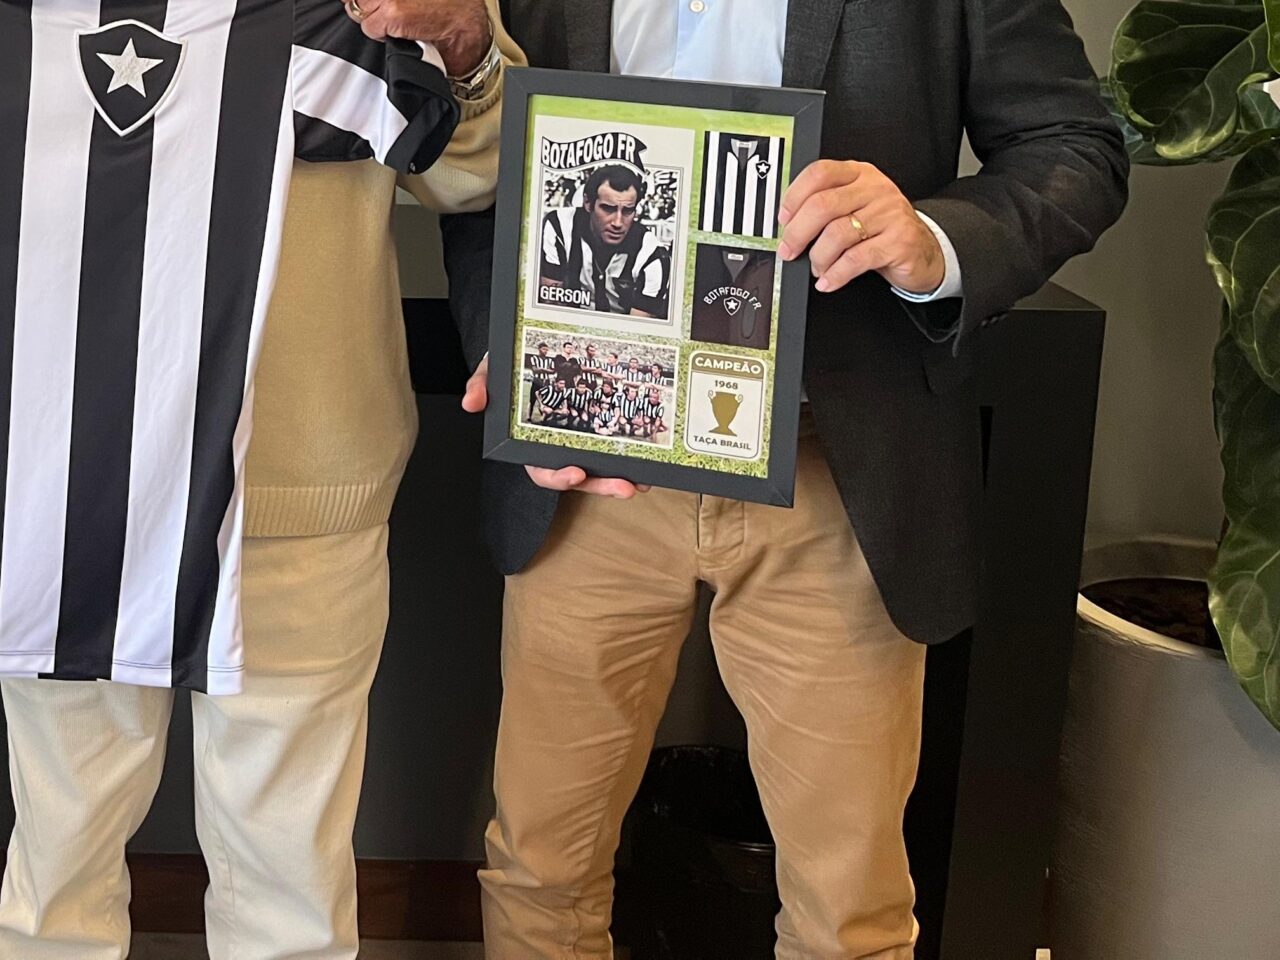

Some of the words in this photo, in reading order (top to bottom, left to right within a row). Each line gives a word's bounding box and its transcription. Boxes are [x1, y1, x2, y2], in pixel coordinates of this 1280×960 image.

[541, 133, 614, 169] BOTAFOGO
[617, 133, 636, 164] FR
[540, 285, 590, 306] GERSON
[703, 286, 751, 305] BOTAFOGO
[748, 296, 762, 310] FR
[695, 357, 761, 375] CAMPEÃO
[714, 379, 738, 390] 1968
[693, 435, 718, 446] TAÇA
[720, 439, 752, 450] BRASIL
